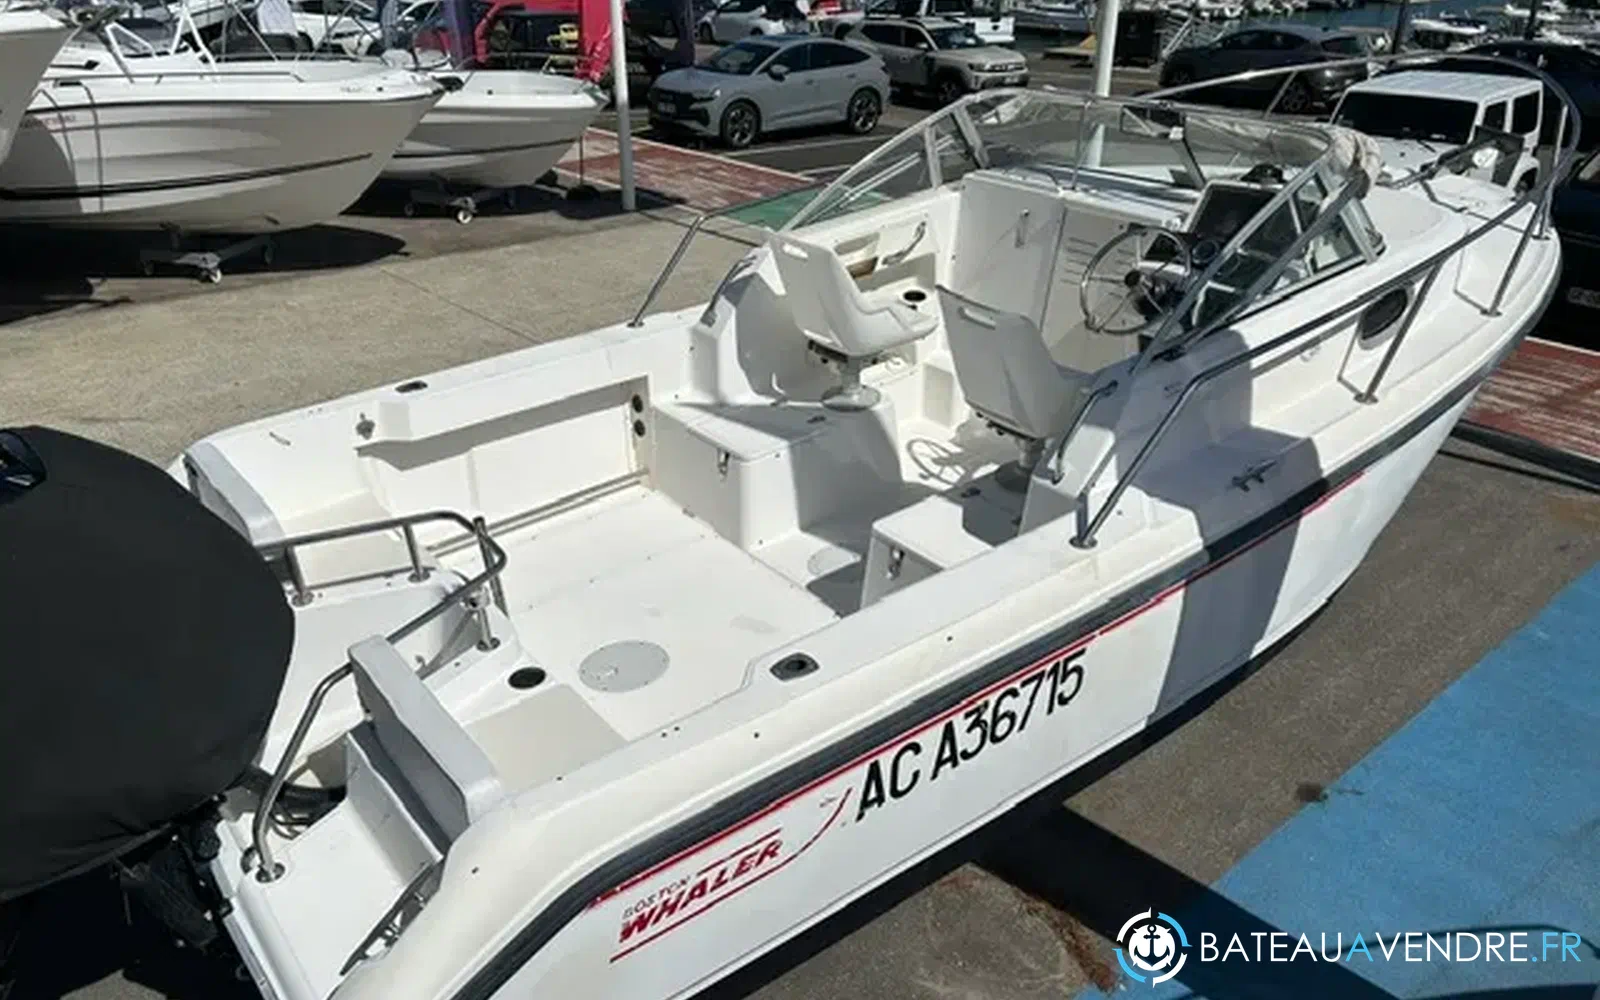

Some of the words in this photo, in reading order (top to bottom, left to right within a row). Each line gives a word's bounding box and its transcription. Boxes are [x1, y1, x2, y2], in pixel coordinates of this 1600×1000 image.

[856, 741, 922, 822] AC
[930, 648, 1087, 781] A36715
[619, 839, 783, 943] WHALER
